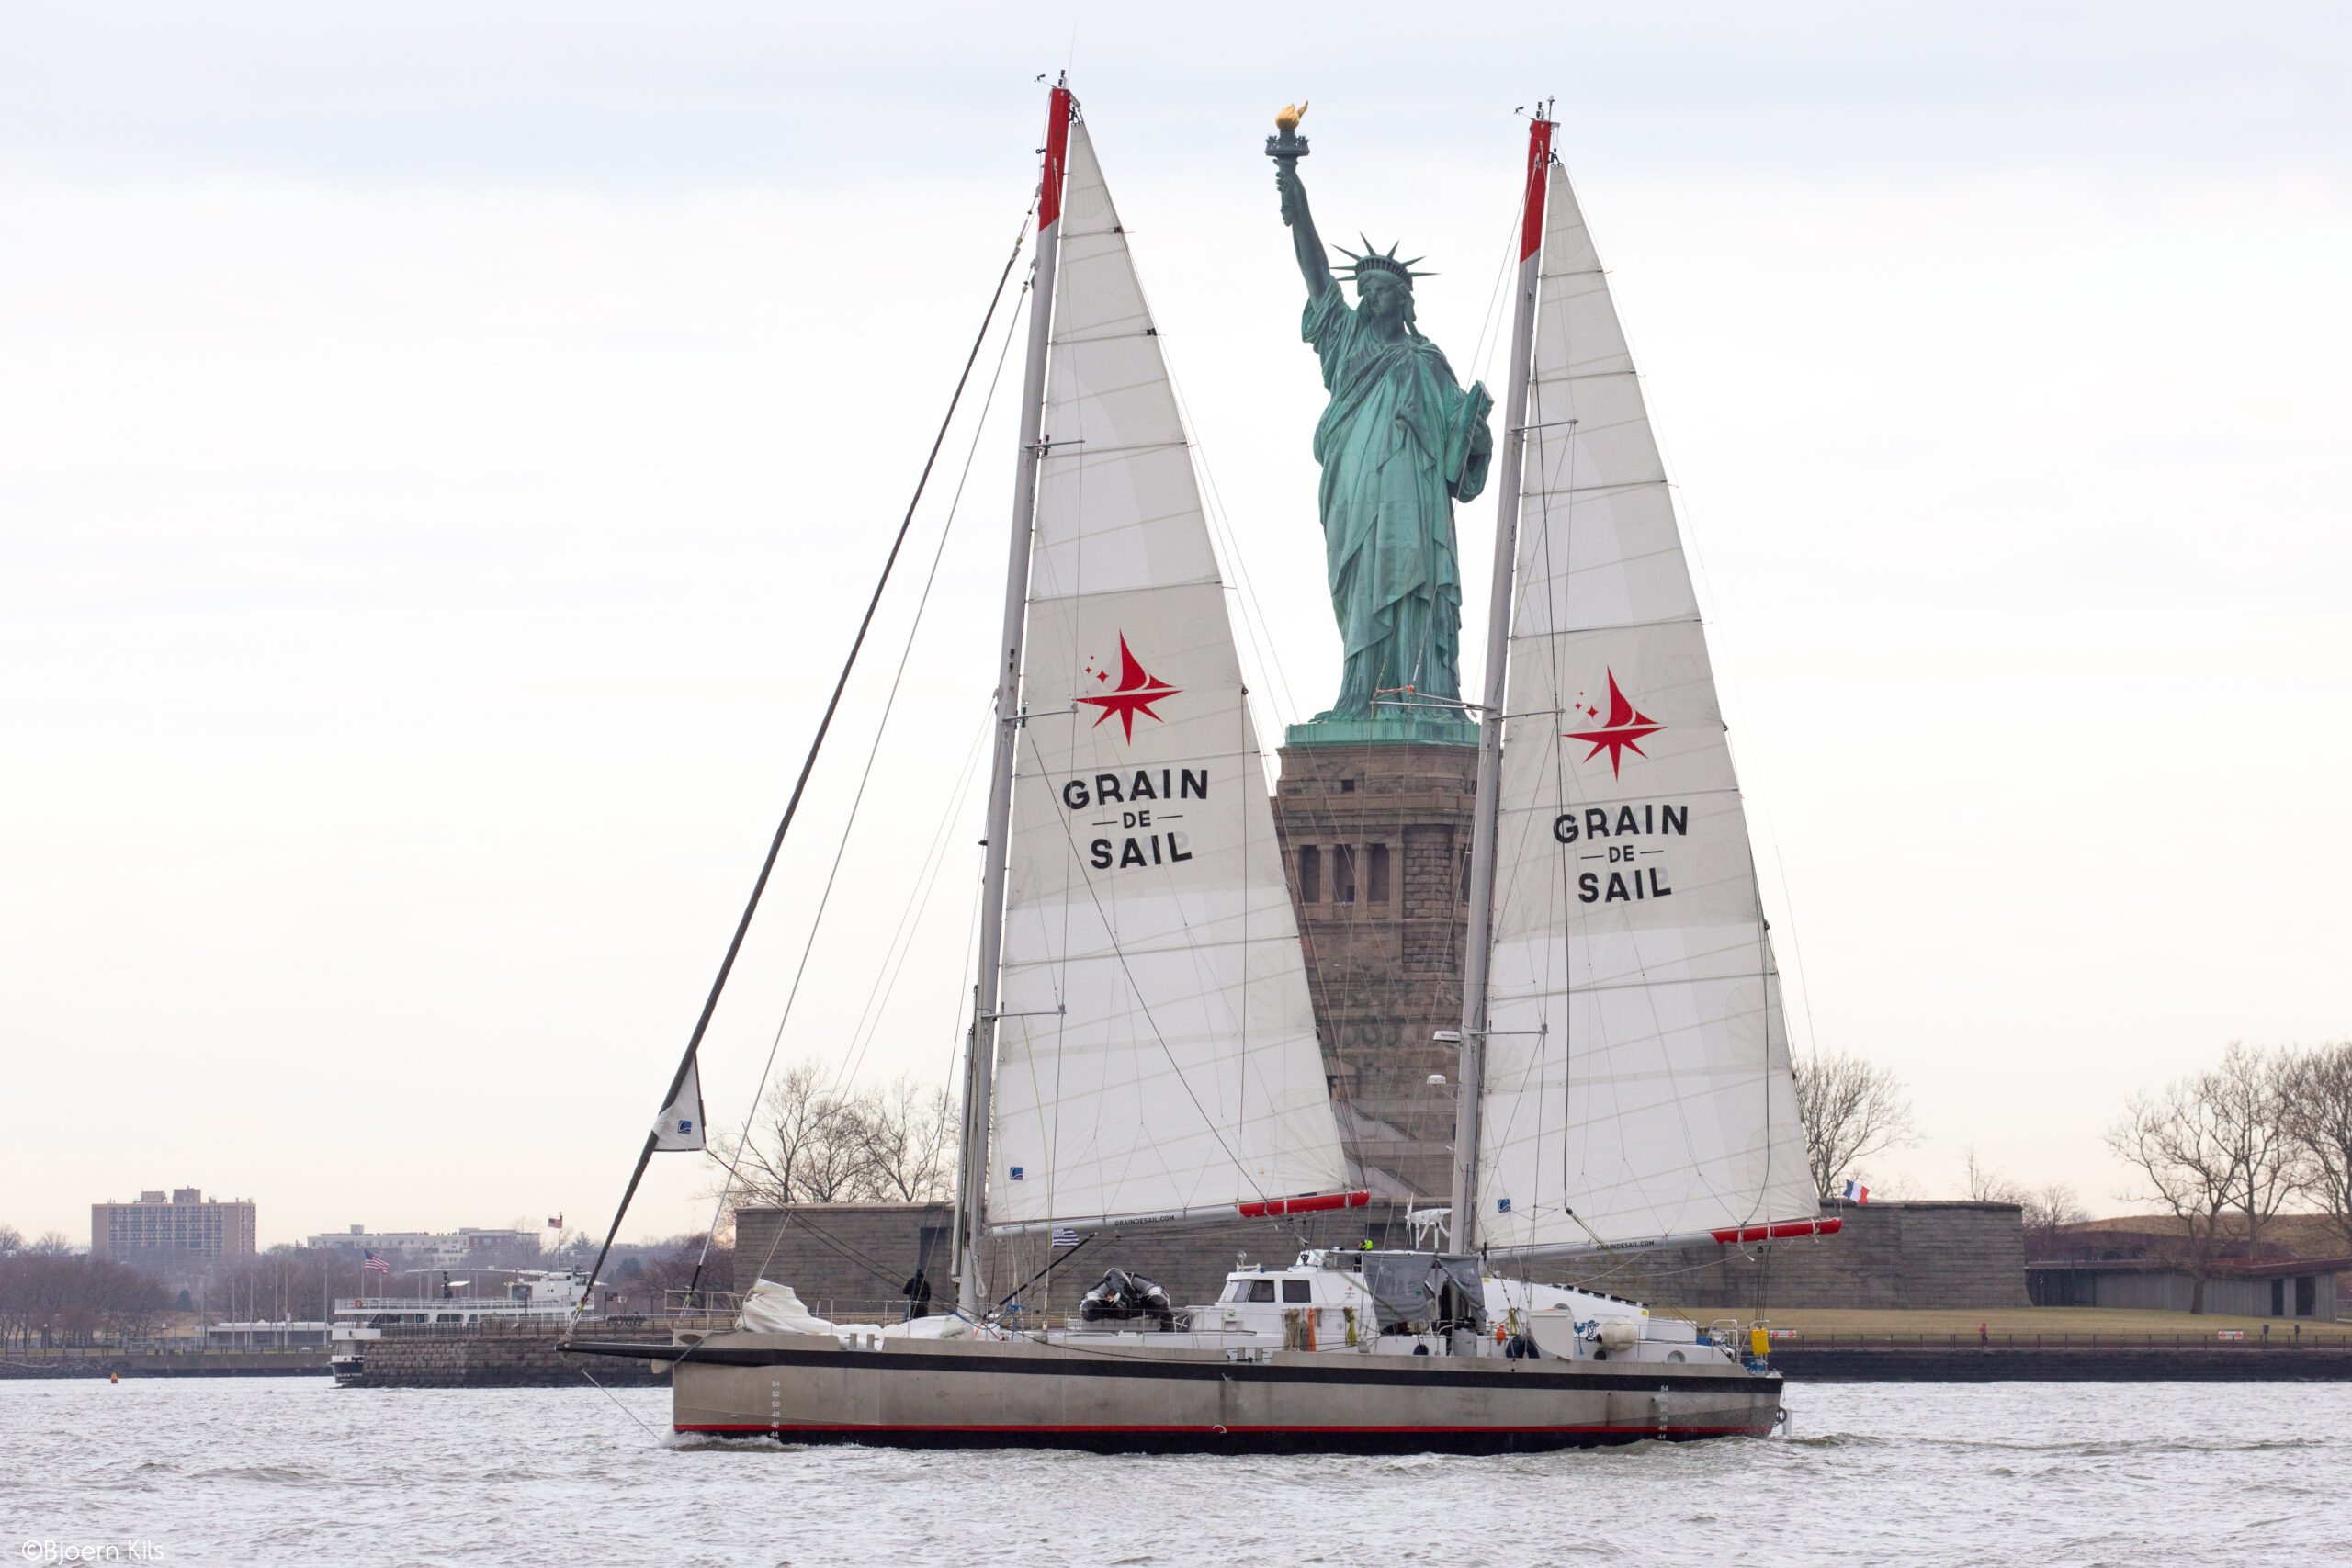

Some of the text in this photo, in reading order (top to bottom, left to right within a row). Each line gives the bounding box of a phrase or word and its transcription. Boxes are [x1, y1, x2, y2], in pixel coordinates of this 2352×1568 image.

[1063, 769, 1208, 809] GRAIN
[1123, 810, 1151, 829] DE
[1554, 805, 1688, 844] GRAIN
[1091, 832, 1193, 869] SAIL
[1609, 845, 1634, 863] DE
[1578, 867, 1672, 903] SAIL
[1114, 1215, 1175, 1226] GRAINDESAIL.COM
